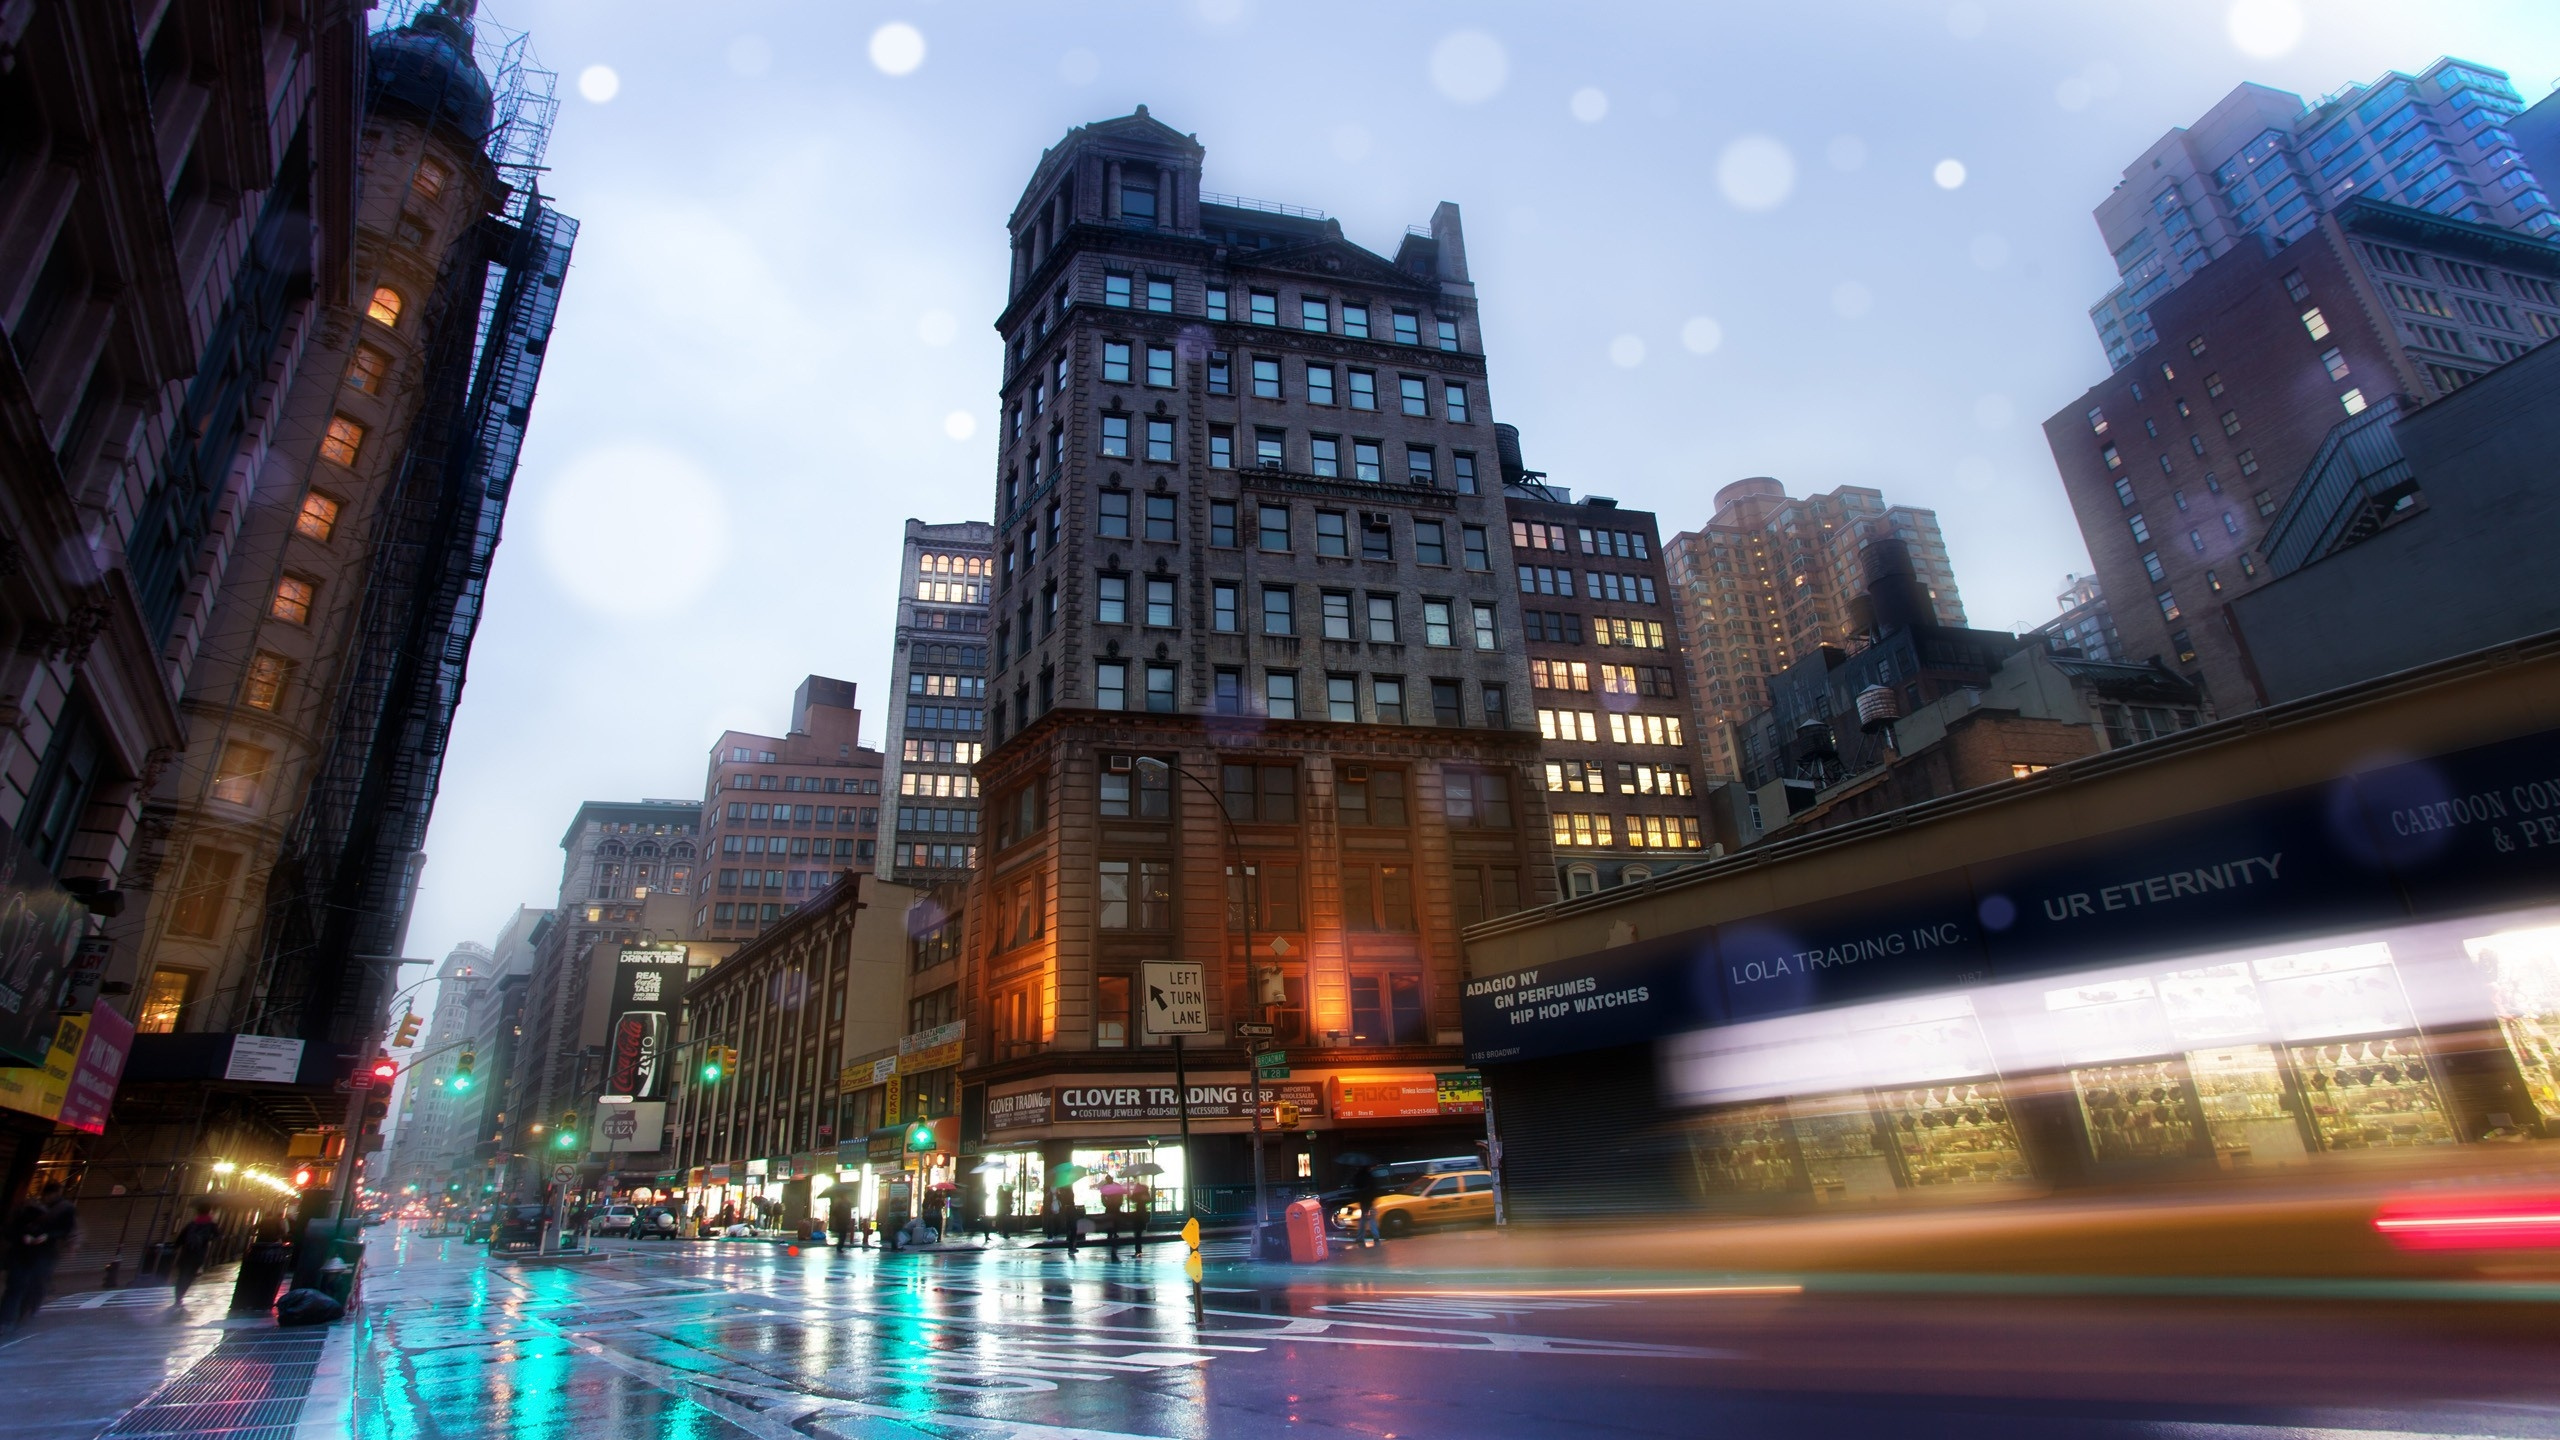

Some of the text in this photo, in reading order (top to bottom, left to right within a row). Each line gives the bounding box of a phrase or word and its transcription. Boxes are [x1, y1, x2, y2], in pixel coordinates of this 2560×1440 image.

[2392, 791, 2508, 836] CARTOON
[2493, 827, 2515, 852] &
[2043, 851, 2283, 922] UR ETERNITY
[620, 955, 684, 964] DRINK THEM
[1731, 922, 1968, 985] LOLA TRADING INC.
[1170, 972, 1197, 985] LEFT
[1466, 970, 1539, 997] ADAGIO NY
[1170, 991, 1201, 1004] TURN
[1494, 977, 1597, 1010] GN PERFUMES
[1510, 986, 1650, 1025] HIP HOP WATCHES
[1173, 1011, 1202, 1024] LANE
[1257, 1053, 1285, 1066] BROADWAY
[1471, 1047, 1521, 1060] 1185 BROADWAY
[1261, 1070, 1268, 1078] W
[1271, 1070, 1281, 1078] 28
[890, 1080, 899, 1115] SOCKS
[990, 1097, 1014, 1114] CLOVER
[1015, 1092, 1043, 1110] TRADING
[1062, 1088, 1141, 1106] CLOVER
[1079, 1108, 1113, 1118] COSTUME
[1112, 1108, 1143, 1118] JEWELRY
[1166, 1107, 1180, 1116] SILV
[1190, 1106, 1230, 1116] ACCESSORIES
[604, 1126, 634, 1135] PLAZA
